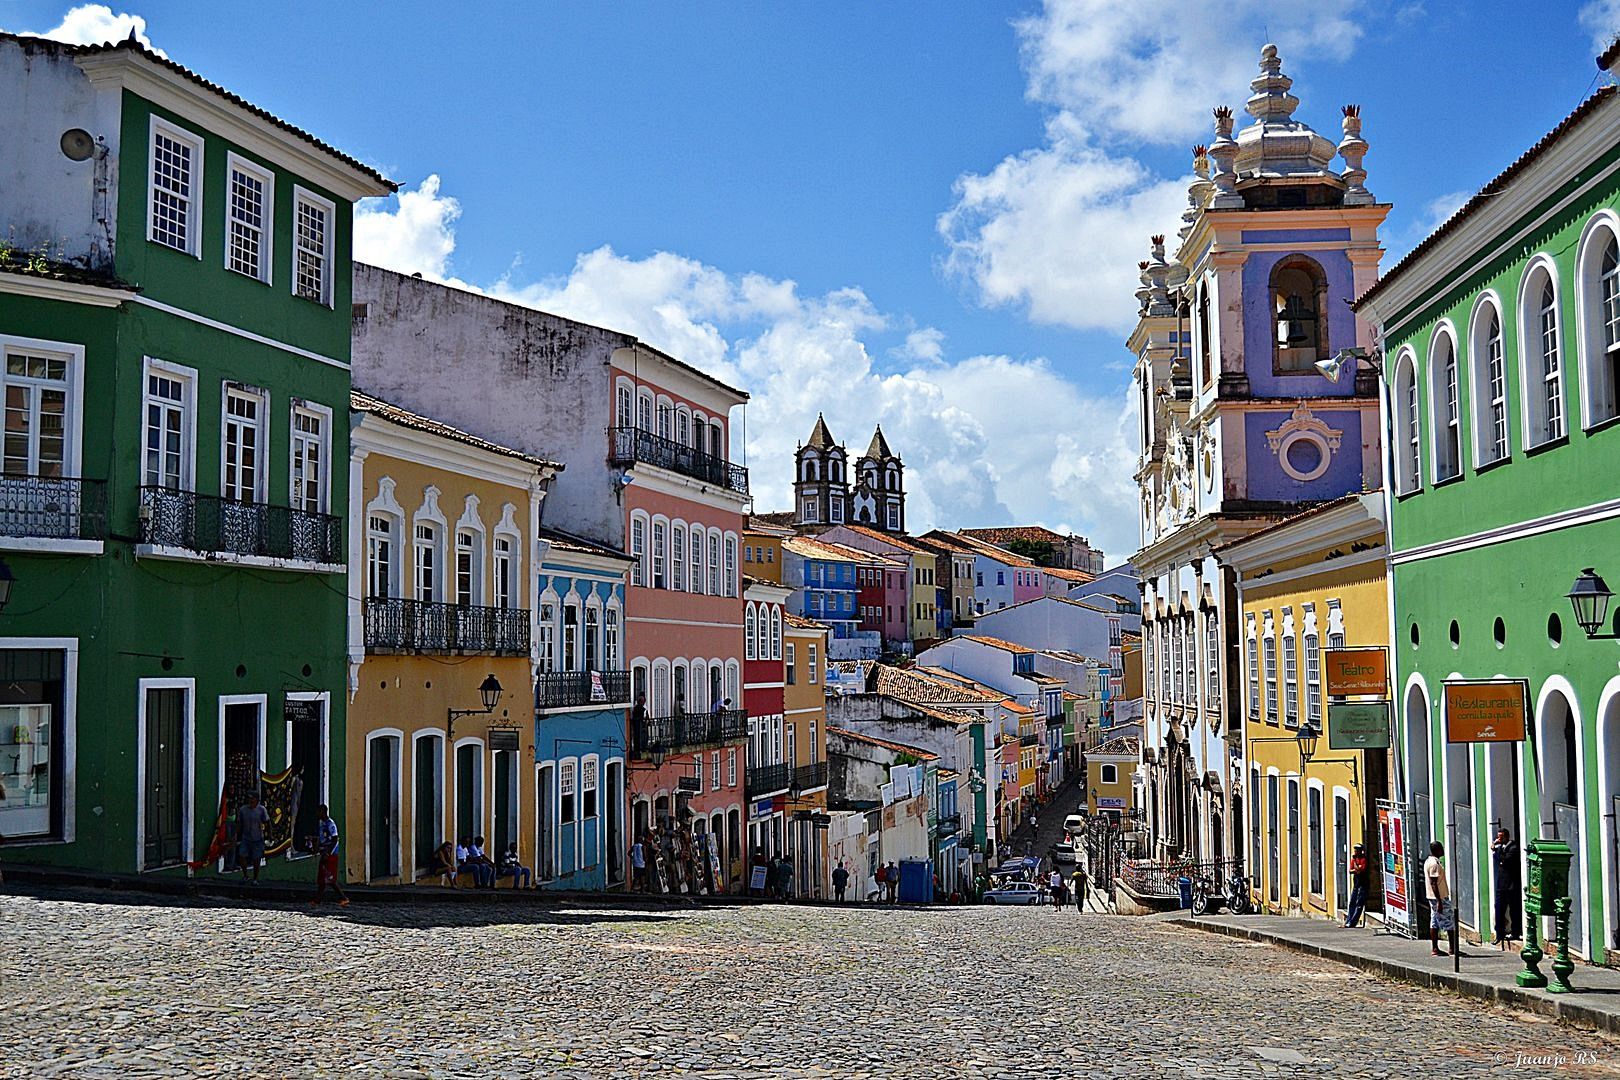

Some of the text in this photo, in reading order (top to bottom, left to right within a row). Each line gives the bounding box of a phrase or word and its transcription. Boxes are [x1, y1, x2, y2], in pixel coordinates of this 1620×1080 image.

[1337, 662, 1375, 676] Teatro
[1449, 694, 1521, 710] Restaurante
[1456, 711, 1485, 720] comida
[1494, 710, 1515, 723] quilo
